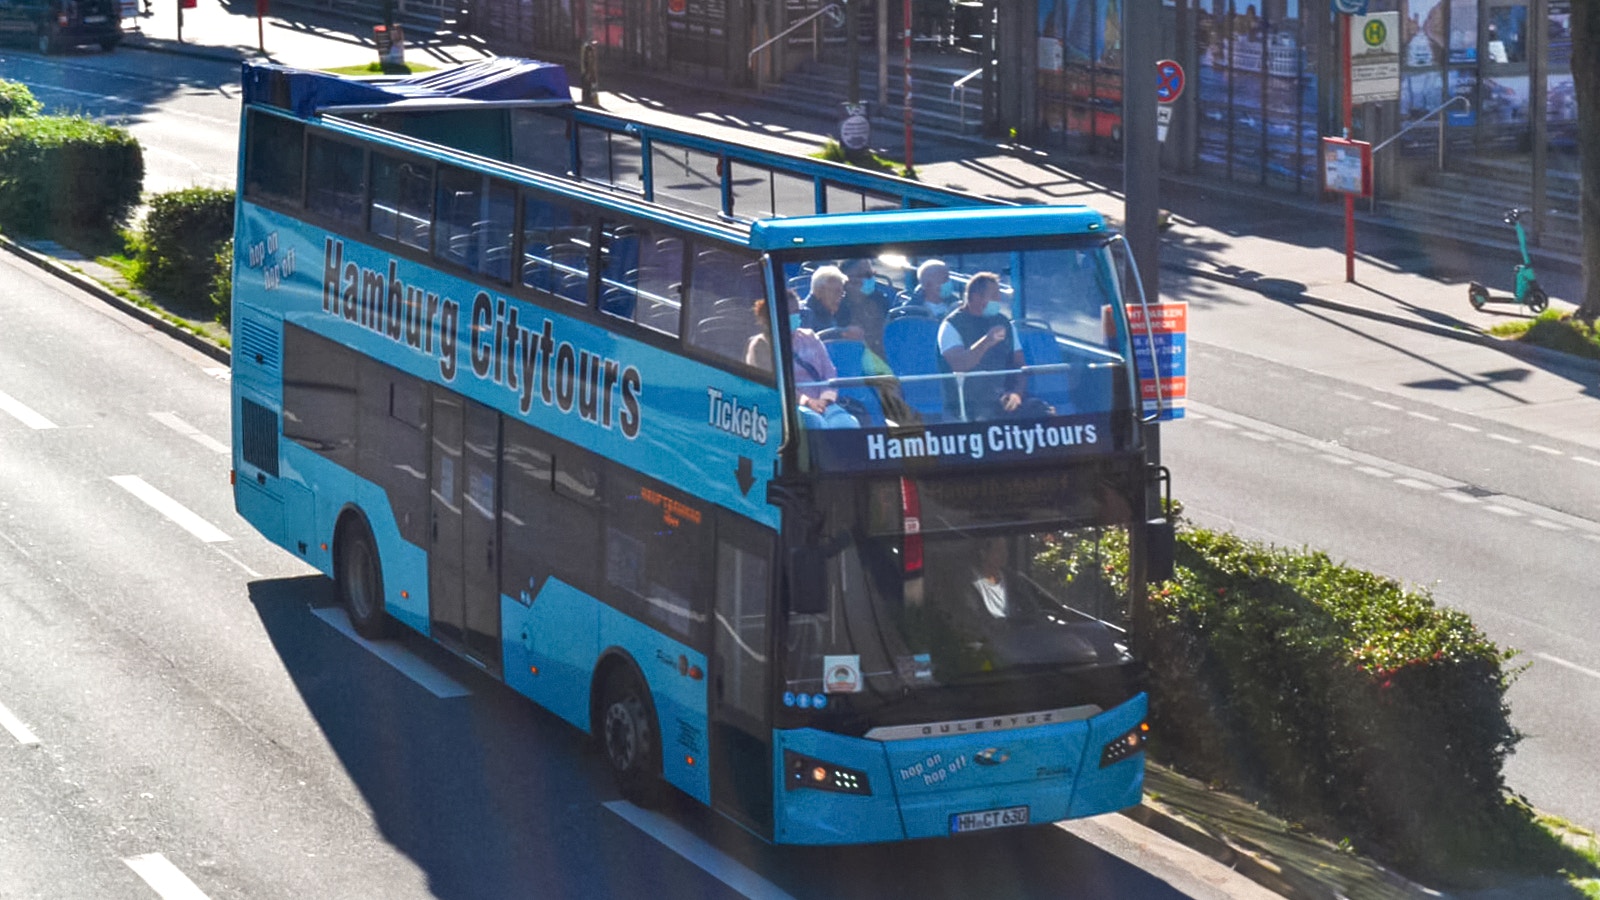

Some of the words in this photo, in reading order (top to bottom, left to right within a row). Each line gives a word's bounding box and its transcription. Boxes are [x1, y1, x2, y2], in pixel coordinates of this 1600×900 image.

[248, 241, 265, 268] hop
[267, 232, 279, 255] on
[264, 264, 280, 290] hop
[282, 247, 296, 278] off
[322, 236, 459, 382] Hamburg
[470, 290, 642, 440] Citytours
[707, 387, 768, 445] Tickets
[867, 431, 984, 460] Hamburg
[987, 424, 1098, 455] Citytours
[901, 763, 923, 781] hop
[926, 754, 941, 768] on
[923, 768, 946, 785] hop
[959, 815, 977, 831] HH
[983, 811, 1000, 829] CT
[1002, 807, 1027, 825] 630
